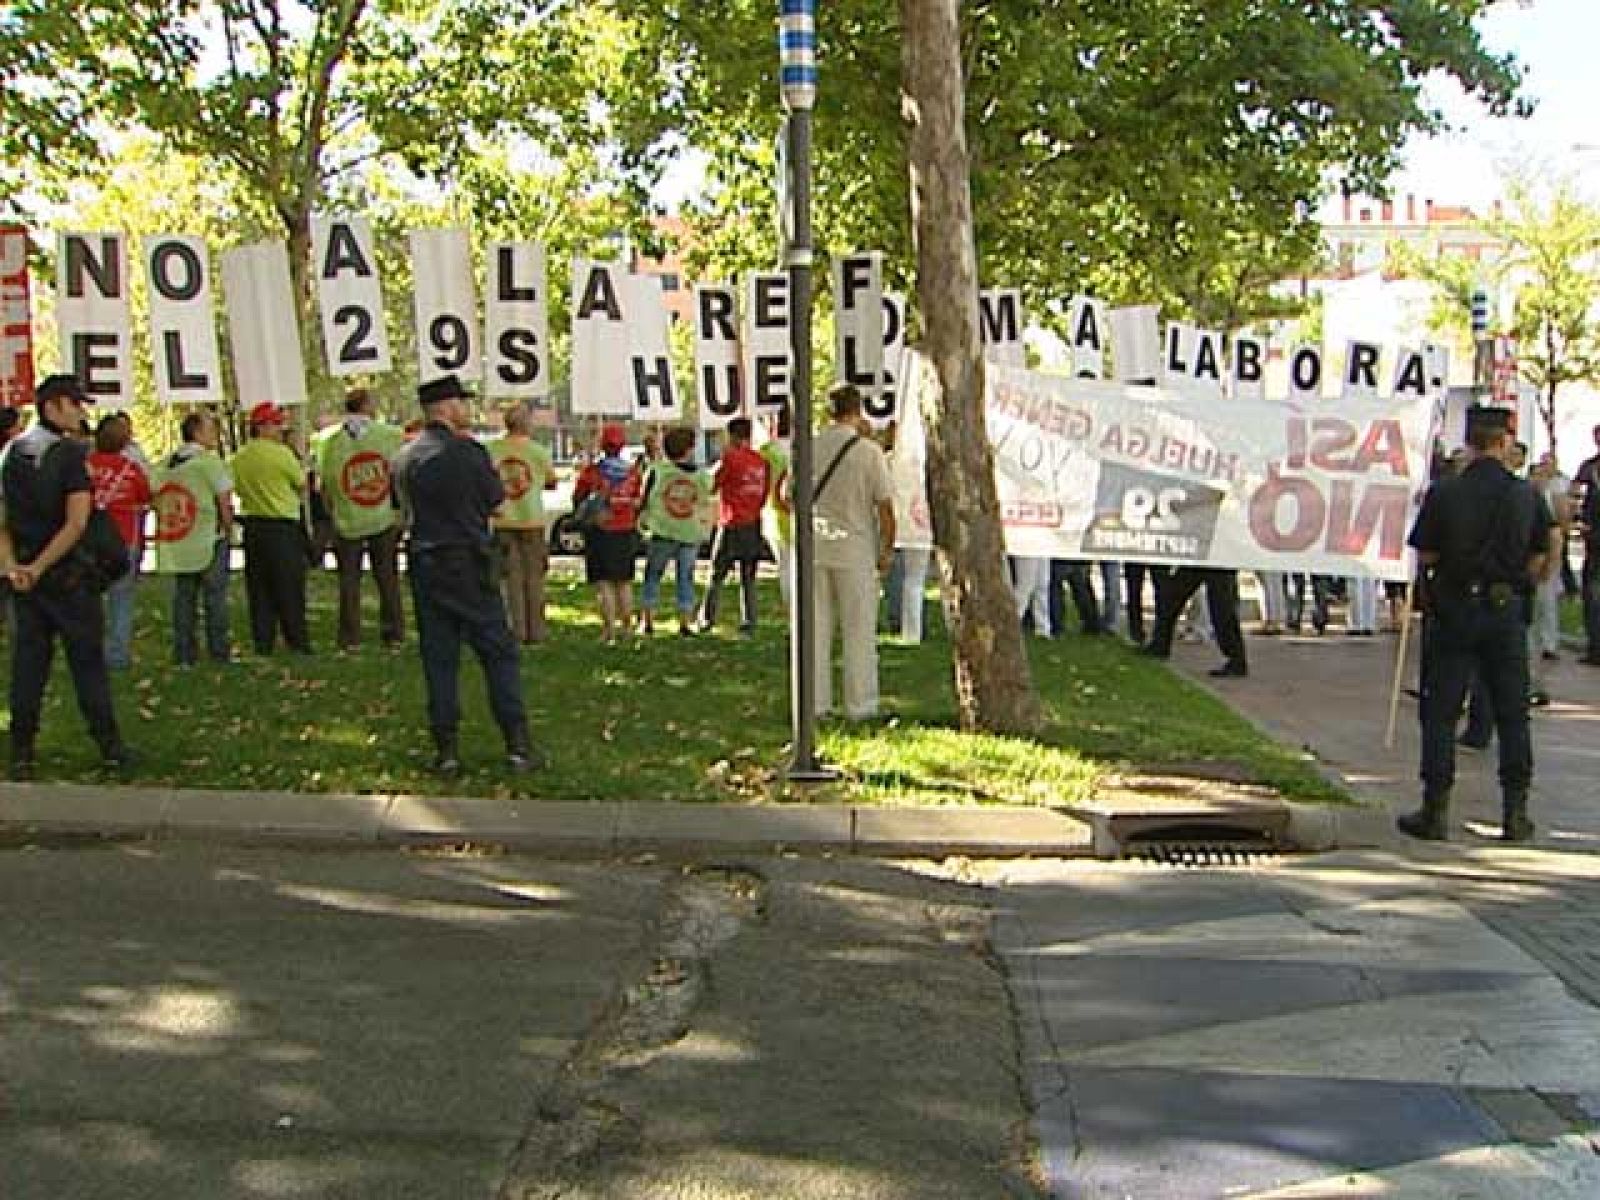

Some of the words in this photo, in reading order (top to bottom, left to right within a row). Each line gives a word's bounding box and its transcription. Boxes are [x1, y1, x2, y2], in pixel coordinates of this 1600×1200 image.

[66, 236, 203, 301] NO
[323, 224, 371, 279] A
[497, 247, 623, 321] LA
[1169, 326, 1441, 396] LABORA
[72, 332, 209, 395] EL
